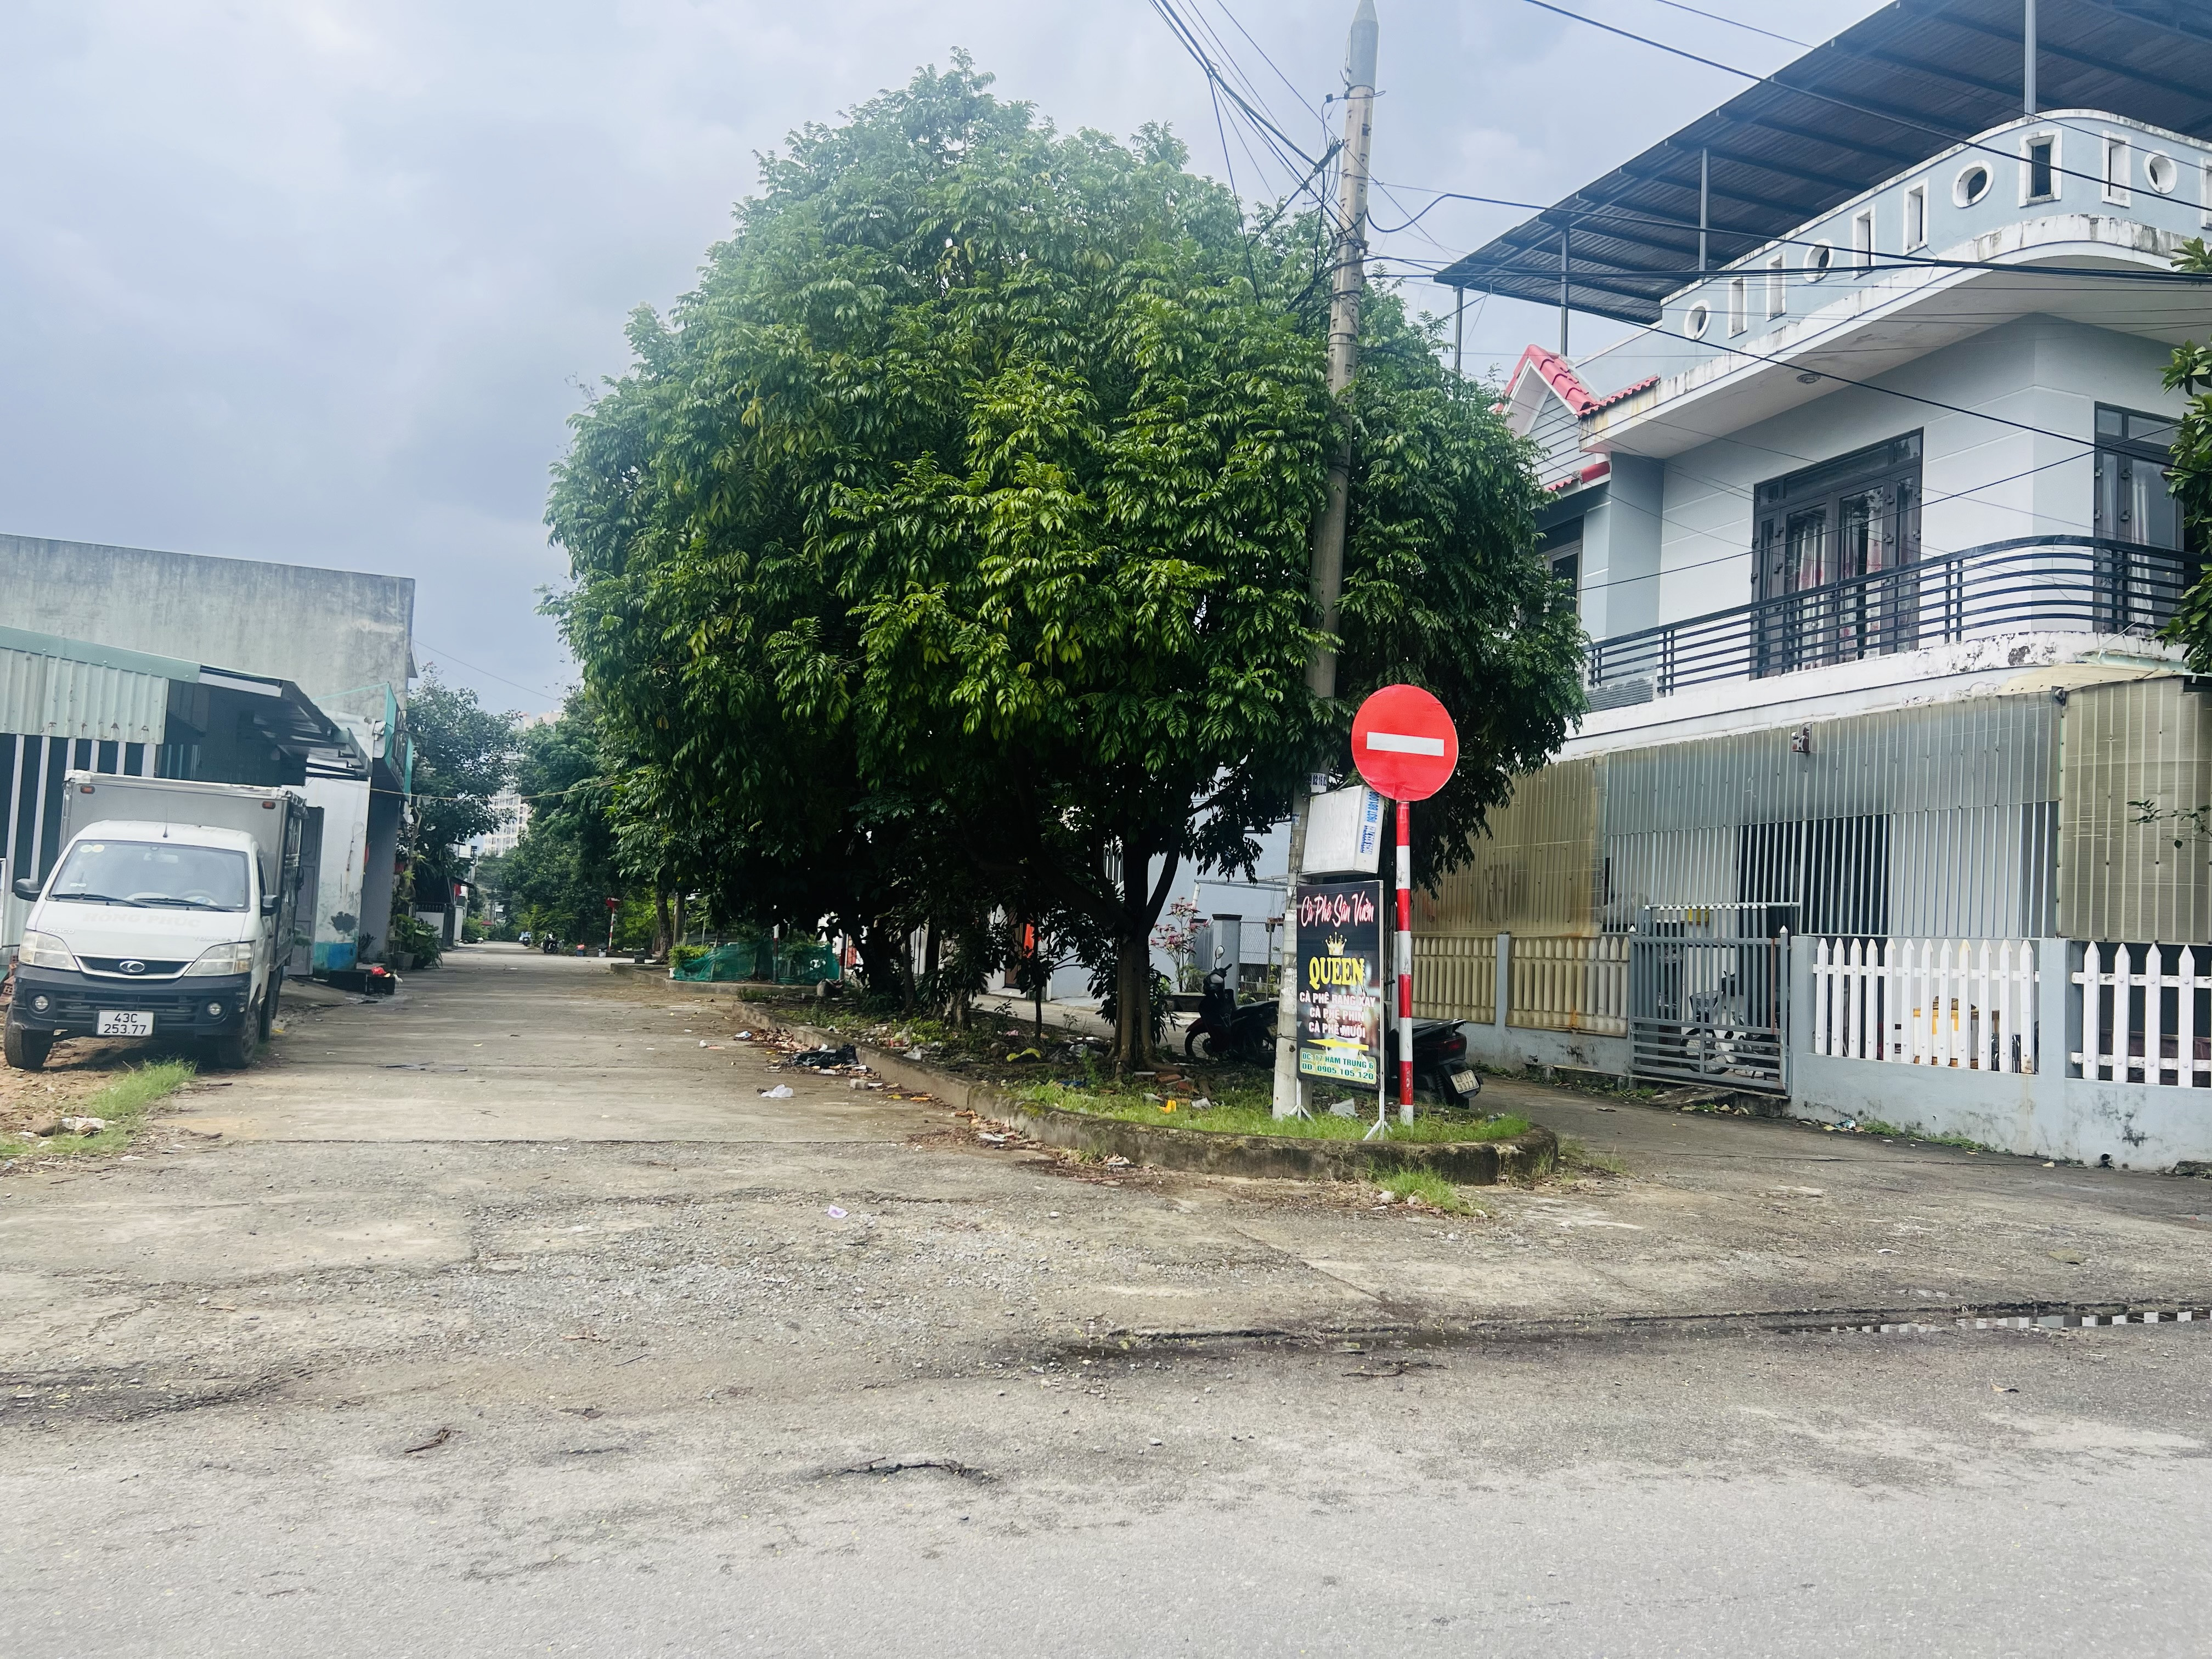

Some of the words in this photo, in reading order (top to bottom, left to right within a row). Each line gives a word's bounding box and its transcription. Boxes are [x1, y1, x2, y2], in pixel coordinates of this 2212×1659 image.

[1301, 896, 1314, 927] Cà
[1314, 894, 1332, 927] Phê
[1331, 894, 1351, 927] Sân
[1351, 890, 1374, 927] Vườn
[1309, 957, 1365, 990] QUEEN
[1299, 990, 1311, 1003] CÀ
[1312, 991, 1330, 1004] PHÊ
[1331, 994, 1356, 1006] RANG
[1358, 995, 1376, 1008] XAY
[114, 1013, 138, 1023] 43C
[1309, 1005, 1322, 1018] CÀ
[1323, 1007, 1340, 1020] PHÊ
[1342, 1010, 1365, 1022] PHIN
[104, 1024, 147, 1035] 253.77
[1308, 1020, 1321, 1033] CÀ
[1322, 1022, 1340, 1035] PHÊ
[1341, 1023, 1366, 1039] MUỐI
[1343, 1058, 1367, 1069] TRUNG
[1317, 1065, 1374, 1080] 0905.105.120
